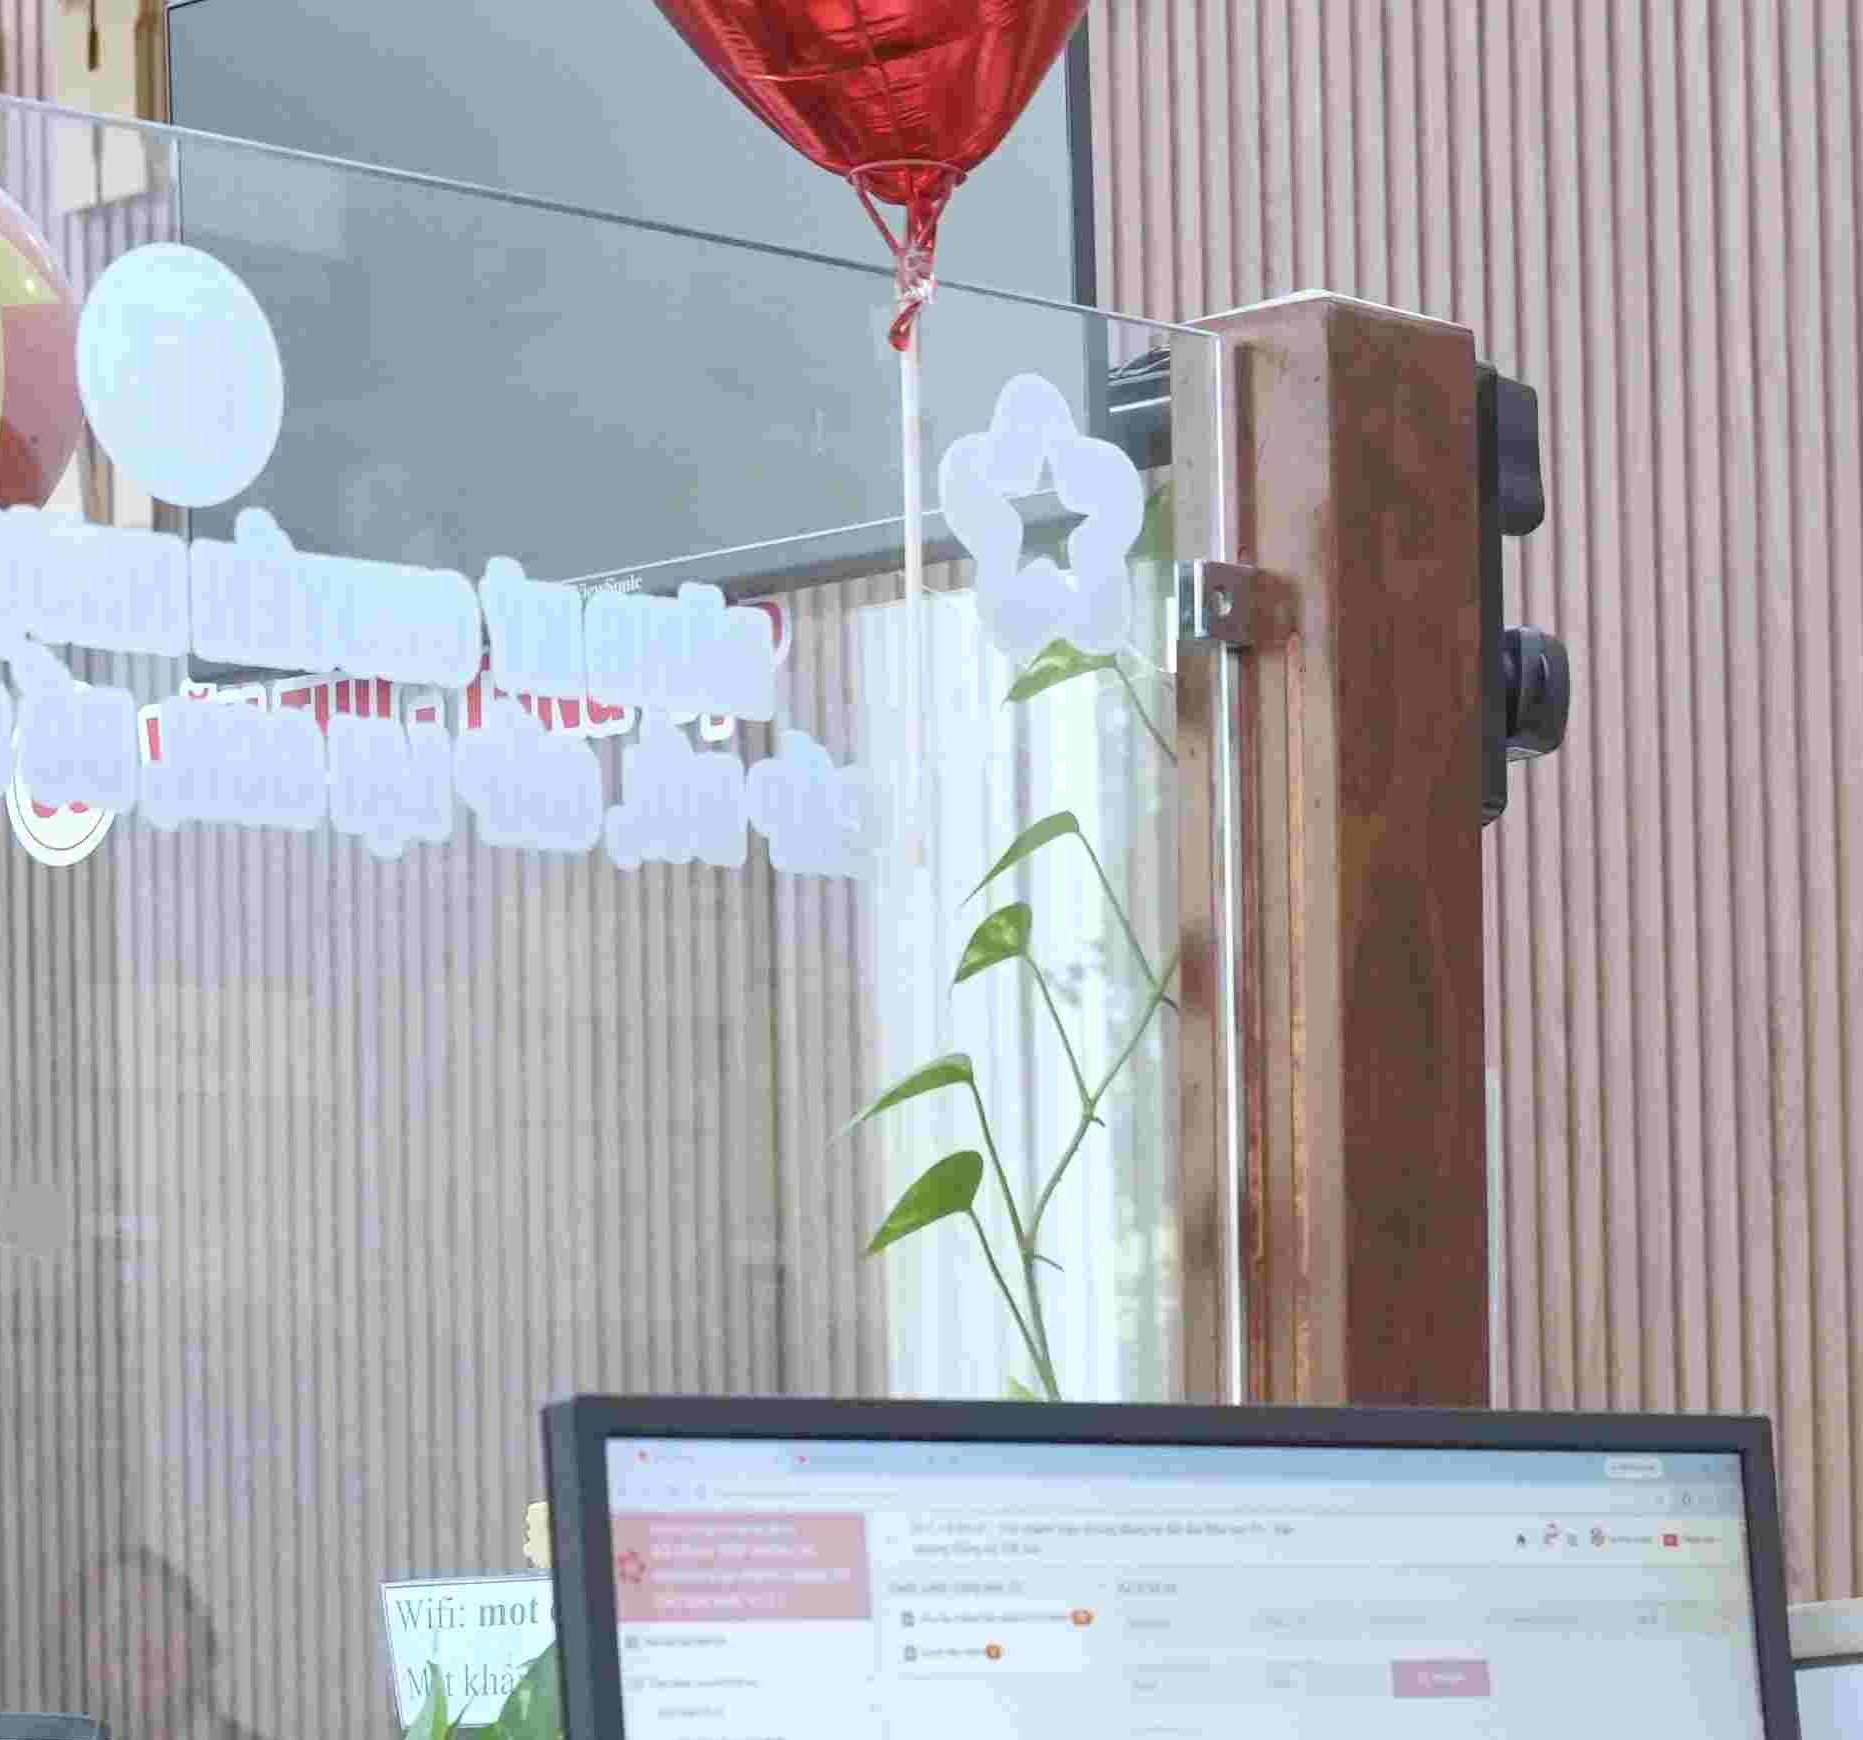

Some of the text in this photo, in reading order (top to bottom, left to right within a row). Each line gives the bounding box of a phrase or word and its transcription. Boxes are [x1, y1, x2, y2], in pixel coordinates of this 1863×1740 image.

[395, 1596, 465, 1632] Wifi:
[479, 1596, 539, 1629] mot
[408, 1663, 456, 1698] Mt
